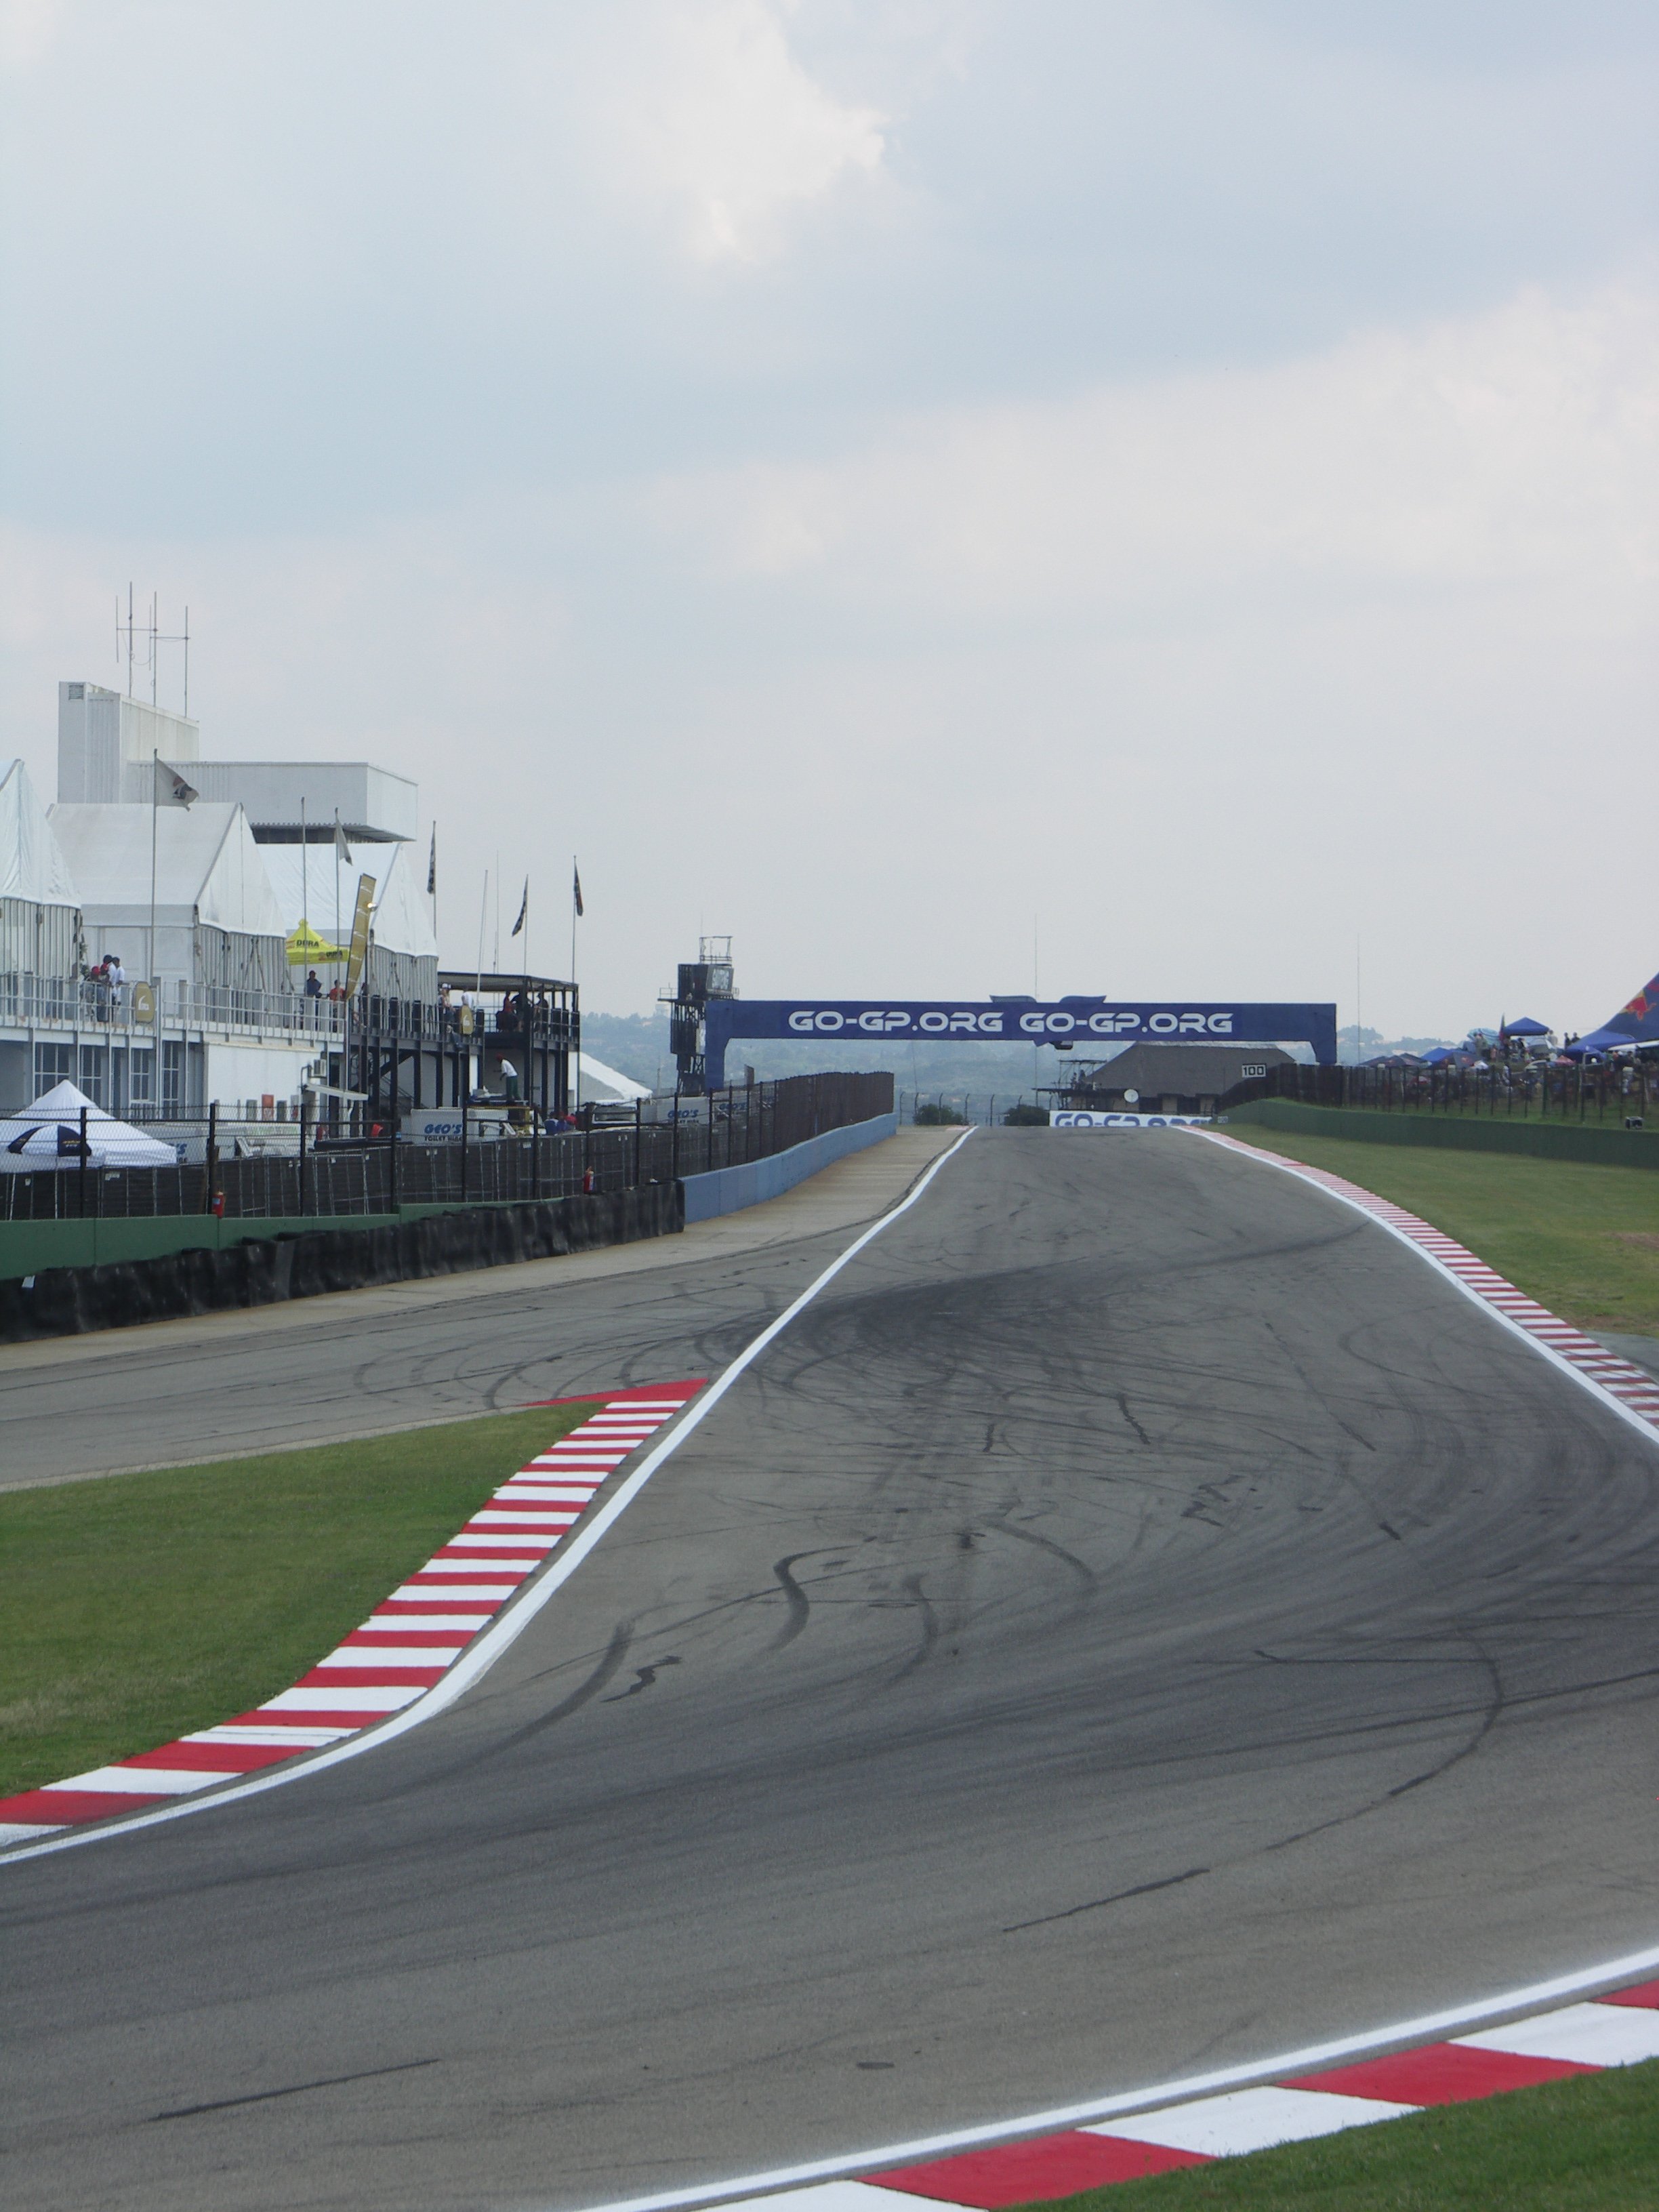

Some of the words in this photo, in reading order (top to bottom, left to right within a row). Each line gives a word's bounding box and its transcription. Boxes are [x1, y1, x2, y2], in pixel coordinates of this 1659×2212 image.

[788, 1010, 1004, 1032] GO-GP.ORG
[1019, 1012, 1234, 1033] GO-GP.ORG
[1244, 1066, 1264, 1076] 100
[424, 1124, 462, 1134] GEO'S
